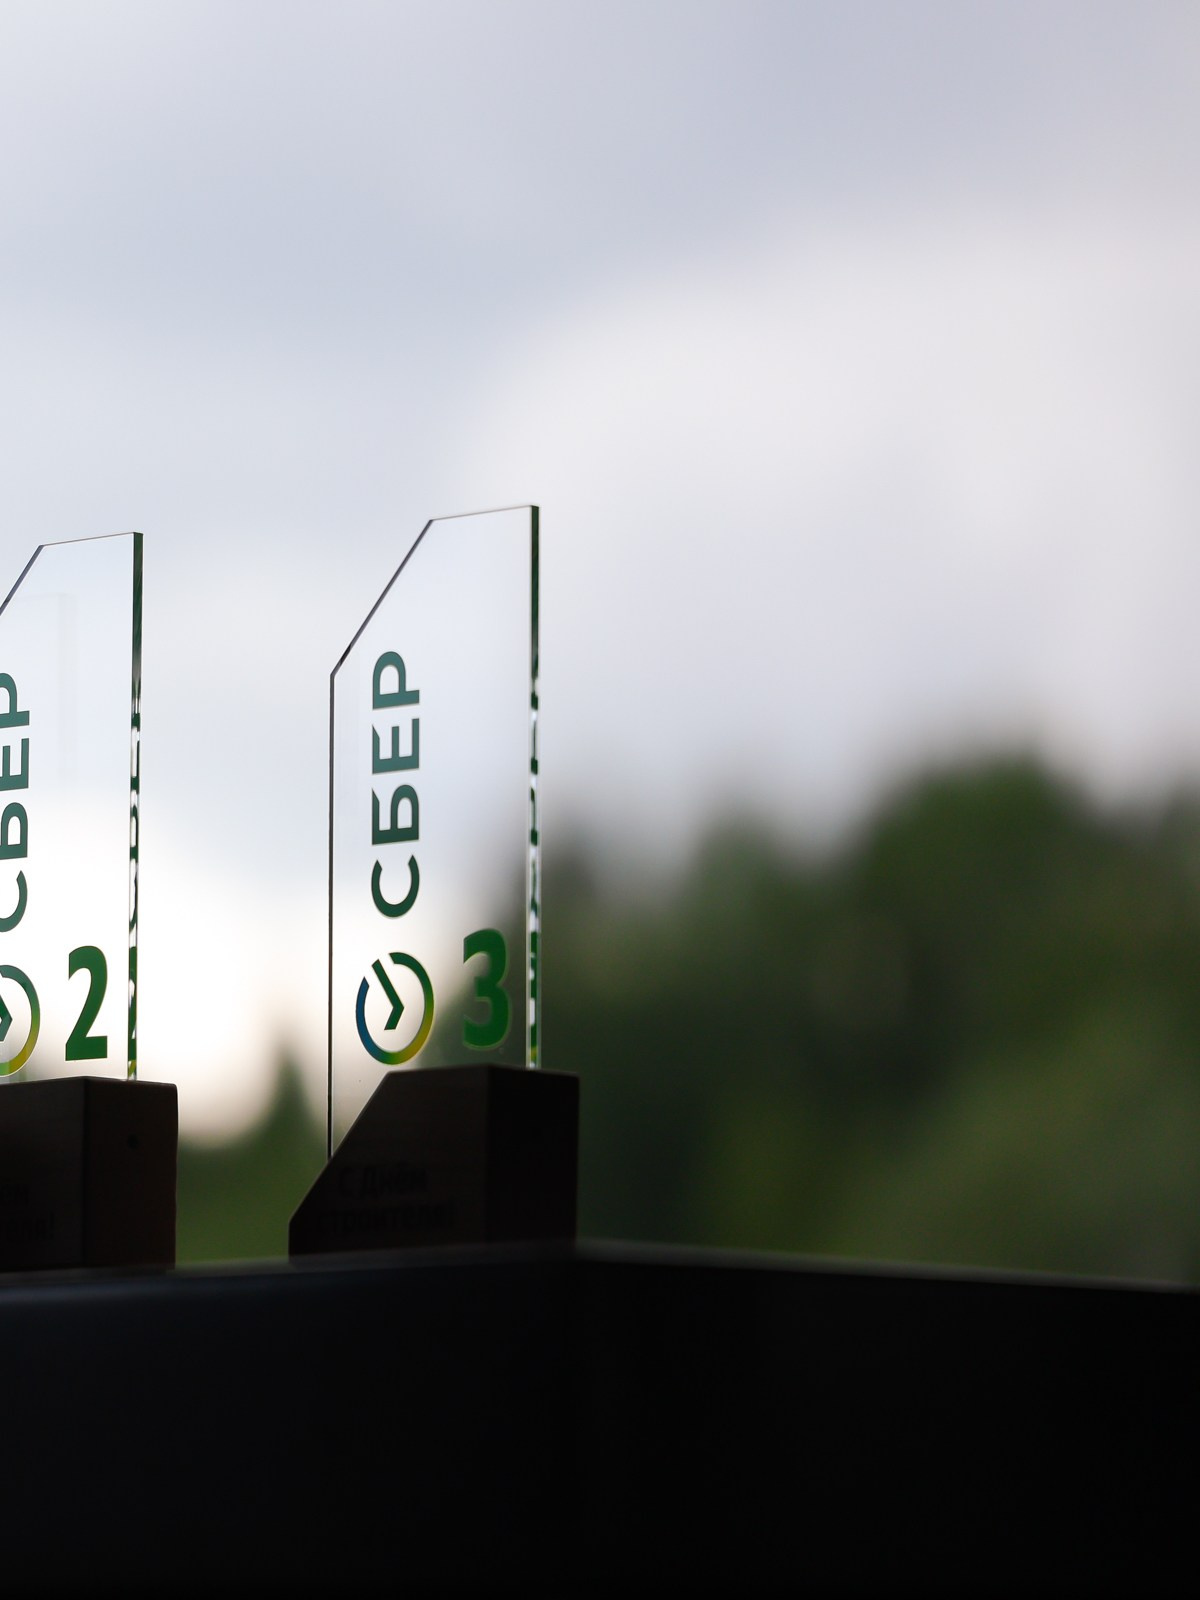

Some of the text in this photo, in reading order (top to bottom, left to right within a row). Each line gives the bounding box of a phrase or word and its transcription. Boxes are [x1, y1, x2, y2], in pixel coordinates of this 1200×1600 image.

[371, 650, 420, 919] СБЕР
[65, 945, 108, 1062] 2
[463, 929, 511, 1051] 3
